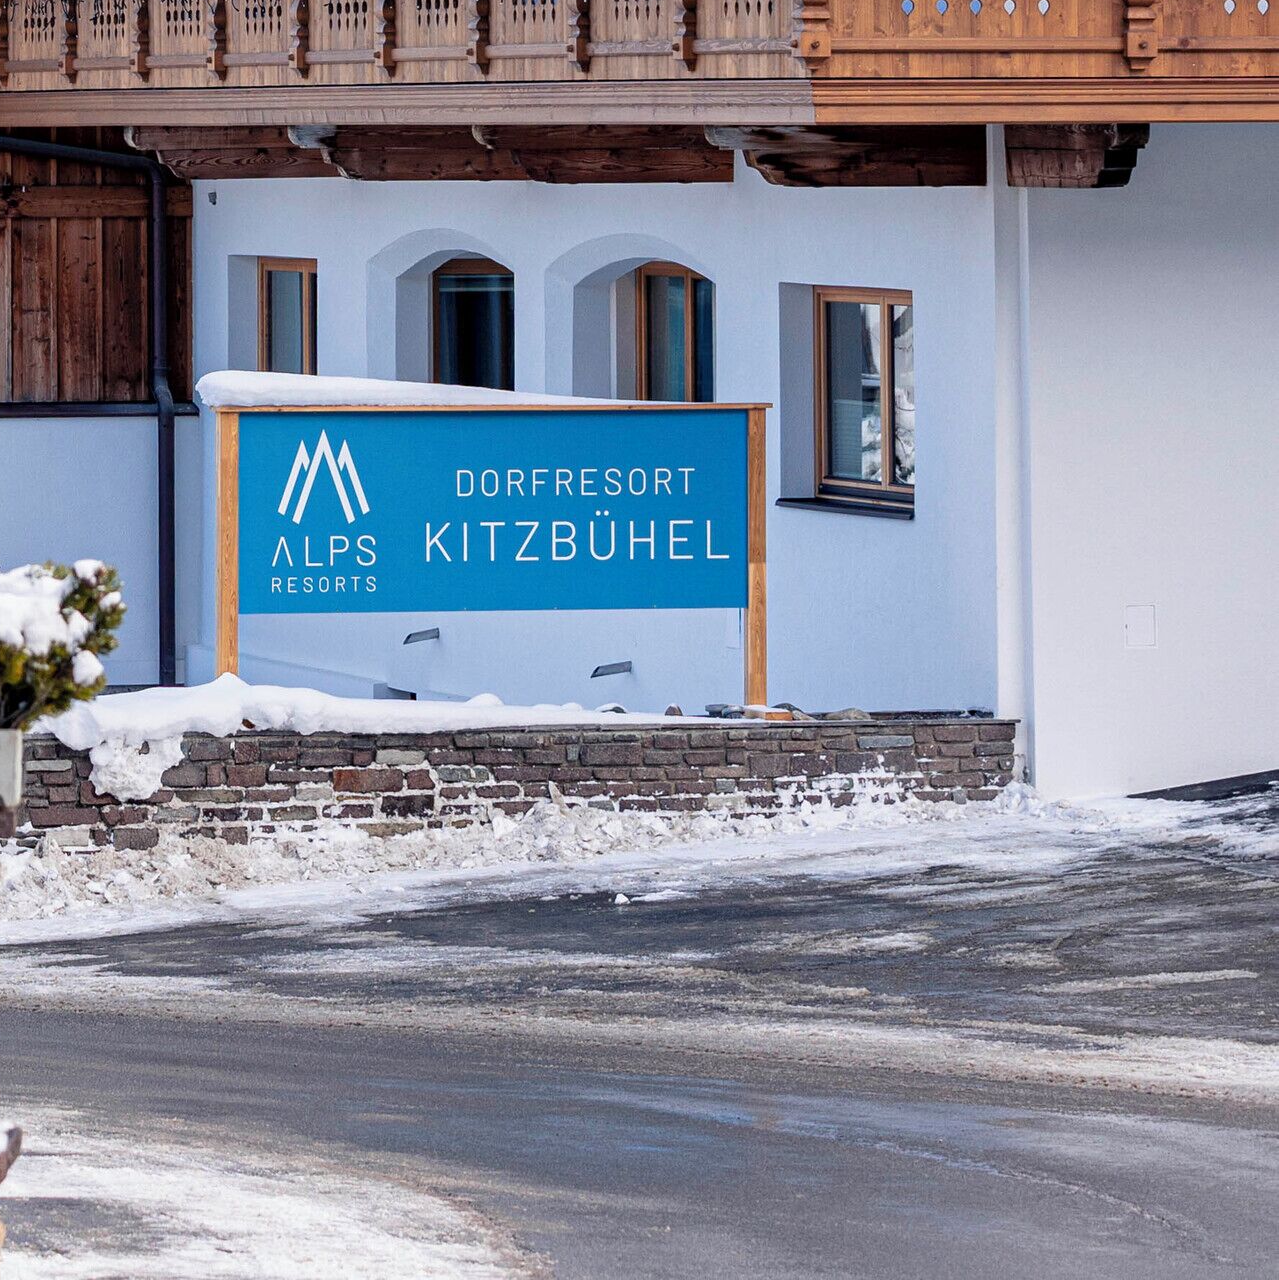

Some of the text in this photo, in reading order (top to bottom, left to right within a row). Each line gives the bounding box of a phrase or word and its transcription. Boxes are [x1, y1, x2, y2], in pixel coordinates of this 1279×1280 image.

[456, 467, 696, 497] DORFRESORT
[271, 534, 377, 567] ALPS
[425, 509, 730, 562] KITZBÜHEL
[271, 575, 378, 593] RESORTS
